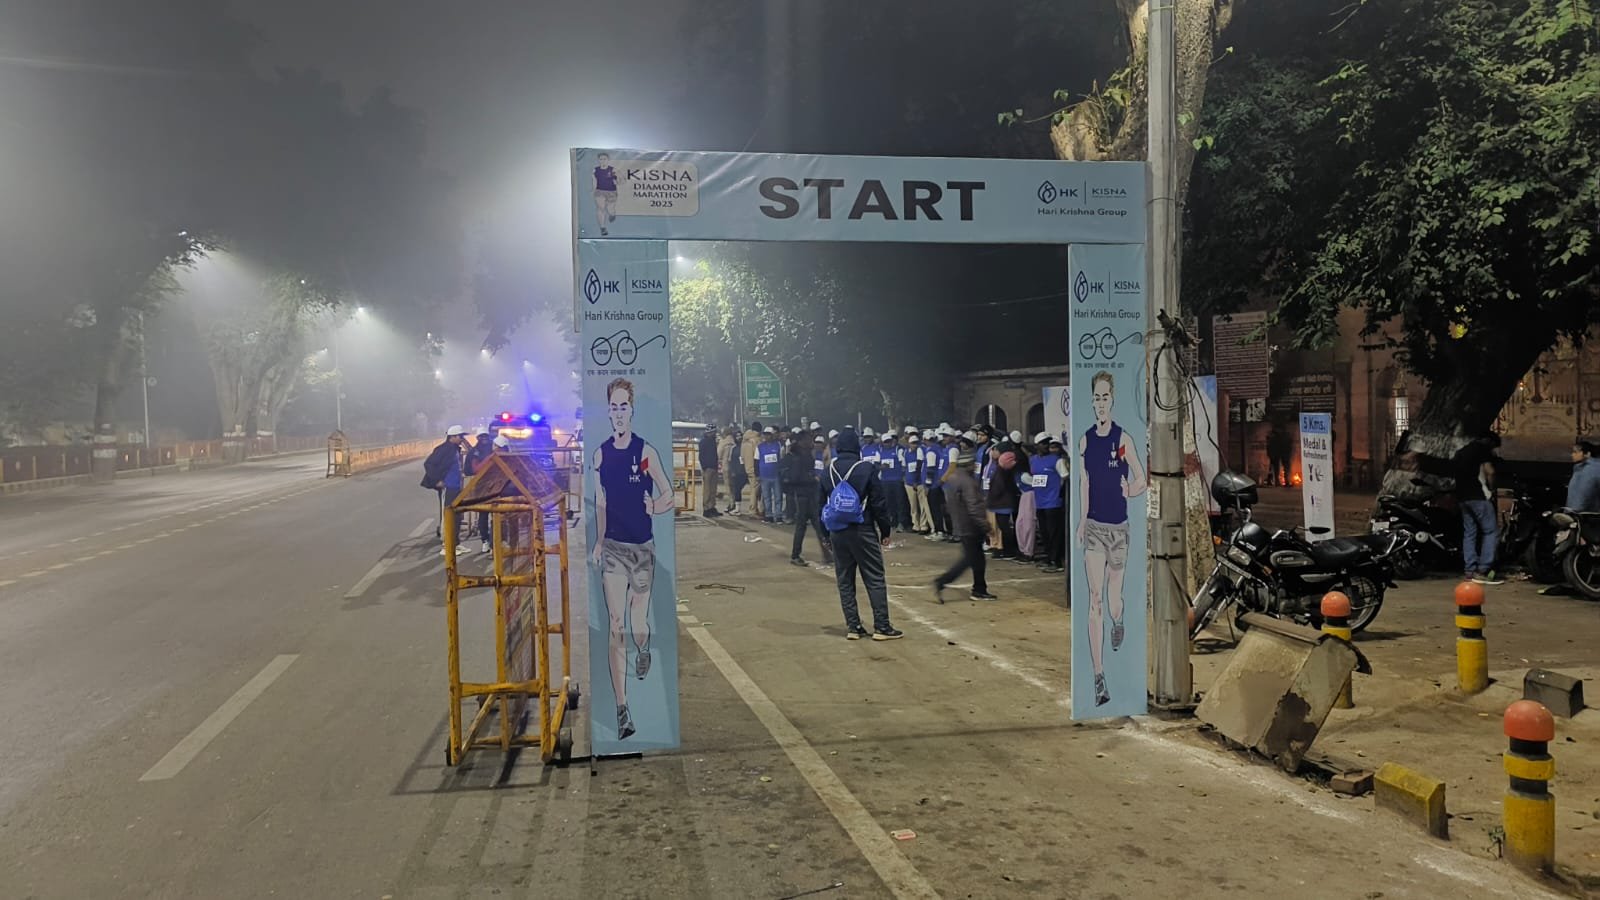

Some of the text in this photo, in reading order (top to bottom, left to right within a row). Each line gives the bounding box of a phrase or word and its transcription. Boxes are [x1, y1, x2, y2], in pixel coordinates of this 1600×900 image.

[627, 169, 692, 182] KISNA
[634, 183, 687, 191] DIAMOND
[1092, 188, 1127, 196] KISNA
[633, 191, 687, 199] MARATHON
[1059, 188, 1078, 198] HK
[759, 177, 986, 221] START
[1037, 207, 1127, 217] Hari Krishna Group
[603, 281, 620, 293] HK
[632, 280, 663, 289] KISNA
[1090, 282, 1105, 293] HK
[1114, 281, 1141, 290] KISNA
[585, 310, 664, 323] Hari Krishna Group
[1074, 309, 1141, 320] Hari Krishna Group
[1303, 416, 1308, 430] 5
[1303, 437, 1321, 450] Medal
